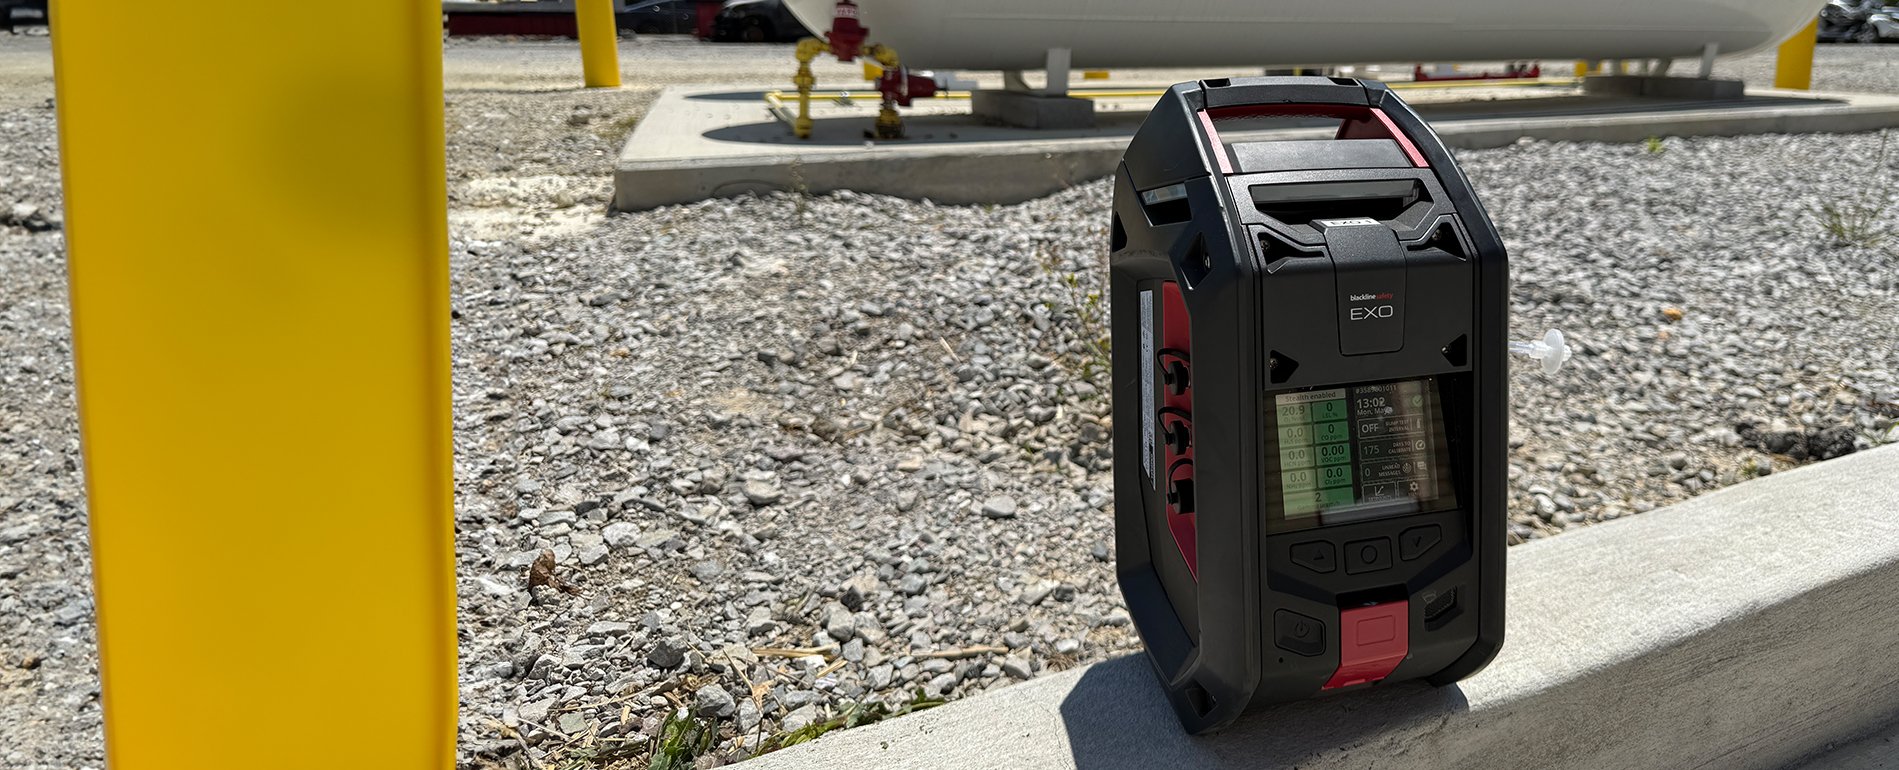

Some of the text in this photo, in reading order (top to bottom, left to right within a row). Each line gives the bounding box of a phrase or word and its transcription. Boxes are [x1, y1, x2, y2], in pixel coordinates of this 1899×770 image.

[1350, 305, 1393, 320] EXO
[1285, 391, 1336, 402] Stealth enabled
[1326, 402, 1333, 412] 0
[1356, 397, 1385, 409] 13:02
[1282, 405, 1305, 416] 20.9
[1287, 428, 1303, 438] 0.0
[1328, 424, 1335, 434] 0
[1362, 423, 1379, 433] OFF
[1289, 449, 1305, 460] 0.0
[1321, 445, 1344, 457] 0.00
[1363, 445, 1380, 455] 175
[1290, 472, 1306, 482] 0.0
[1326, 467, 1343, 479] 0.0
[1364, 467, 1370, 477] 0
[1315, 492, 1322, 502] 2
